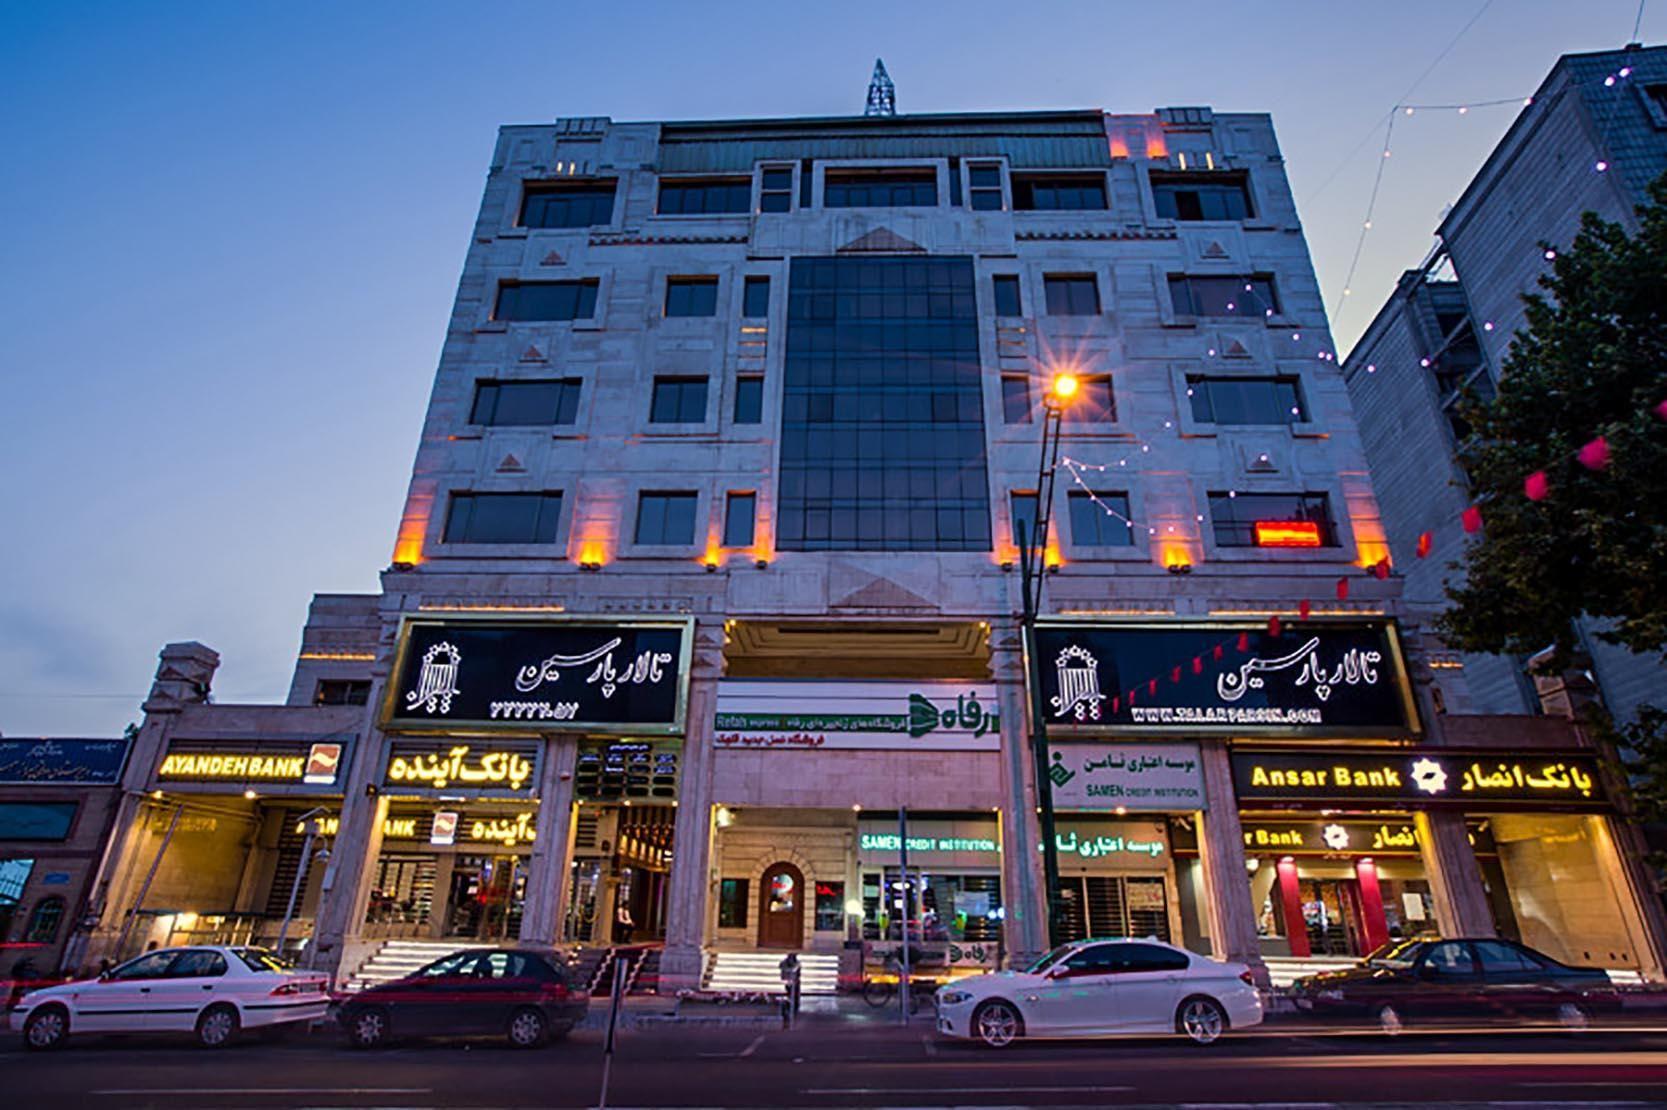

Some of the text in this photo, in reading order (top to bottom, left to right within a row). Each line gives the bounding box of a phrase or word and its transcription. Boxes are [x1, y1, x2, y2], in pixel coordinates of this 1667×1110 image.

[515, 636, 672, 698] تالار پارسین
[1217, 636, 1382, 701] تالار پارسین
[941, 690, 990, 739] رفاه
[159, 754, 305, 778] AYANDEH BANK
[389, 745, 530, 790] بانک آینده
[1252, 766, 1402, 787] Ansar Bank
[1461, 763, 1592, 797] بانک انصار
[1086, 784, 1124, 797] SAMEN
[383, 819, 416, 836] ANK
[471, 813, 531, 845] آینده
[1255, 830, 1304, 846] Bank
